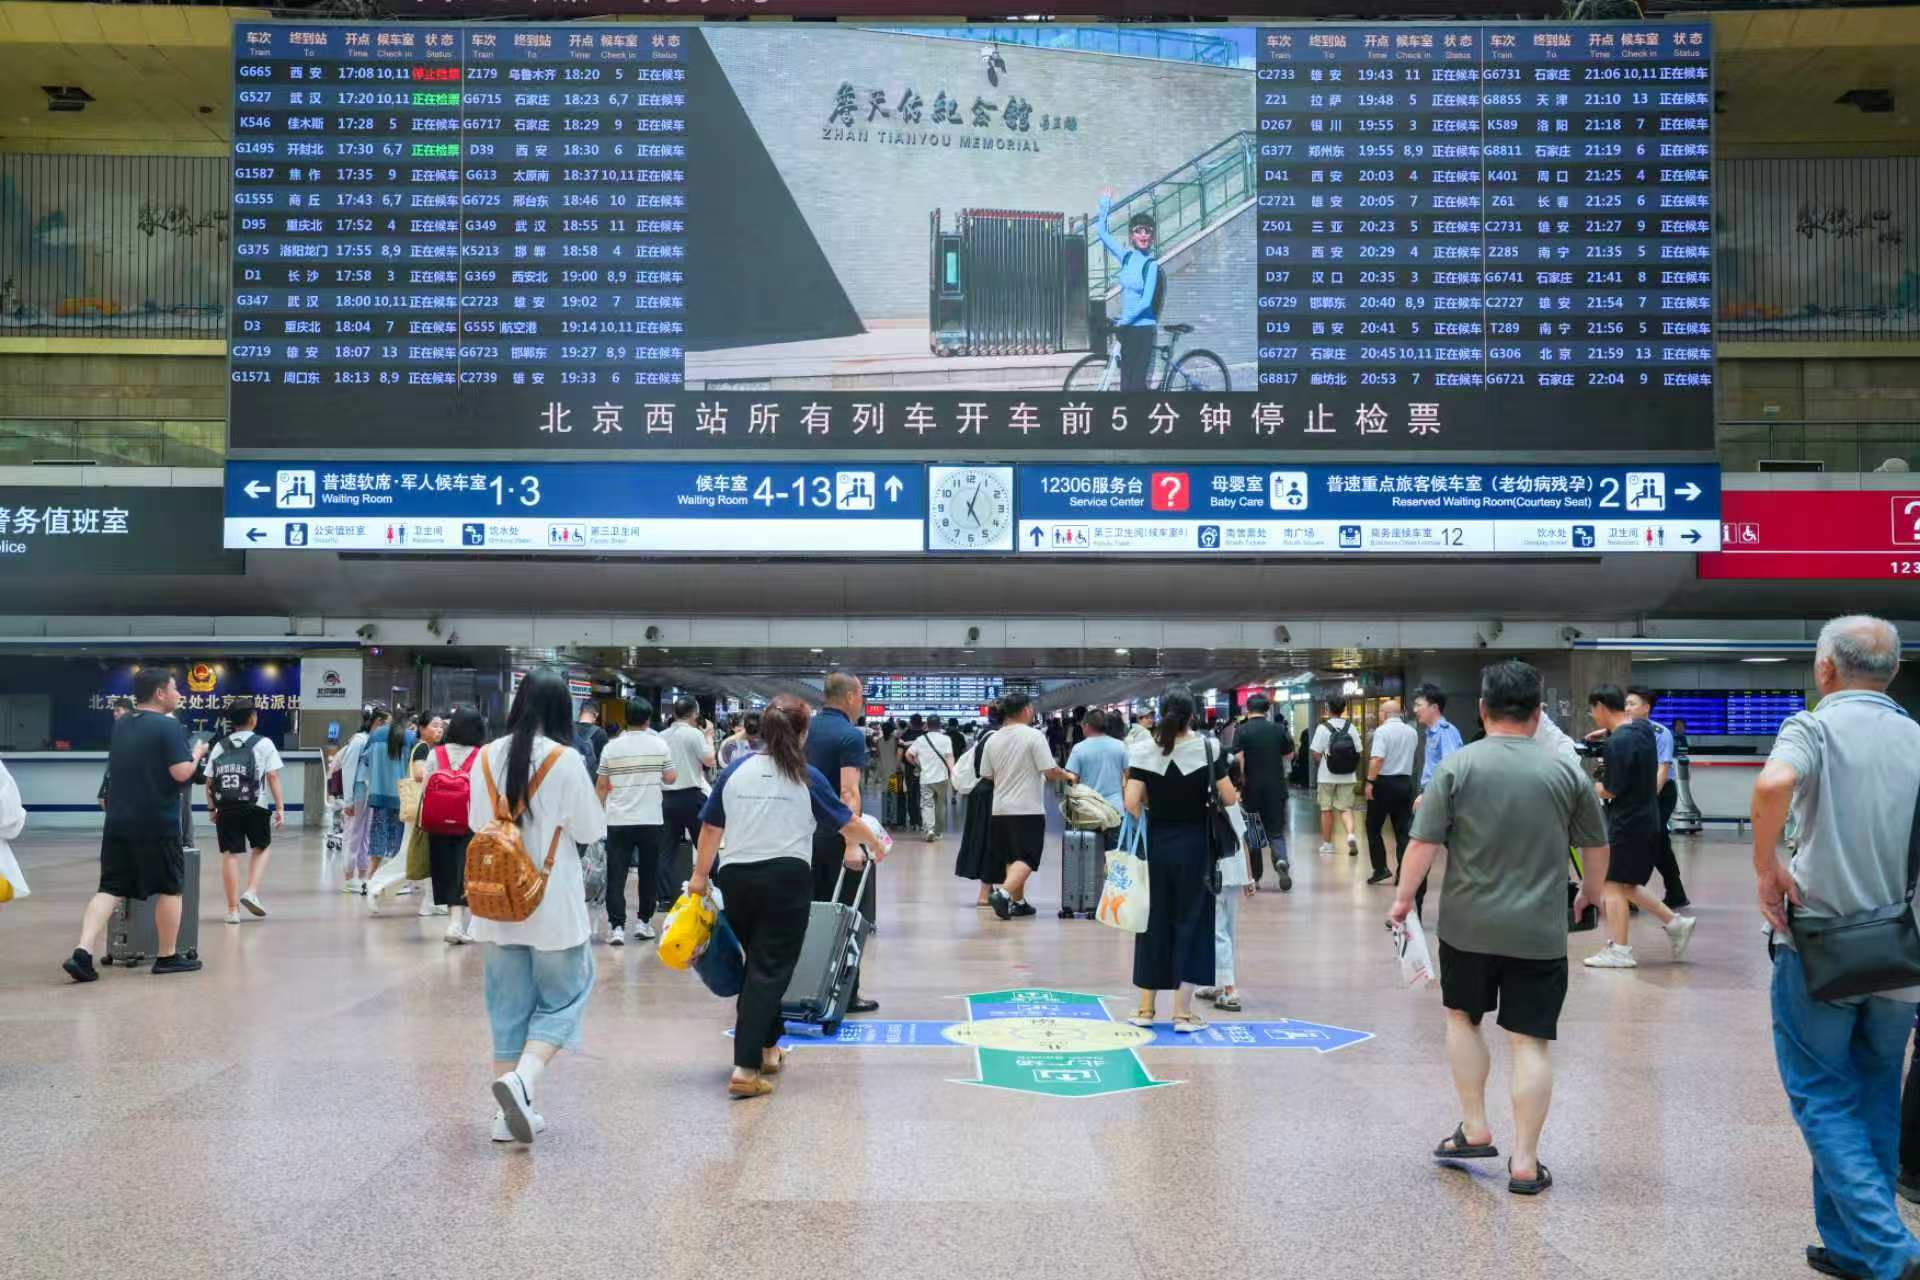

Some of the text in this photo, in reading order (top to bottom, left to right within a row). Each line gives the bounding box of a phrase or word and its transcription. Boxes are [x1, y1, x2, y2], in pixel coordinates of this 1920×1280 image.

[247, 31, 415, 46] 车次 终到站 开点 候车室
[471, 33, 638, 48] 车次 终到站 开点 候车室
[1266, 34, 1433, 48] 车次 终到站 开点 候车室
[1489, 32, 1659, 47] 车次 终到站 开点 候车室
[239, 65, 272, 78] G665
[338, 67, 375, 79] 17:08
[467, 67, 498, 79] Z179
[1257, 68, 1295, 80] C2733
[1484, 67, 1621, 81] G6731 石家庄 21:06
[239, 91, 272, 103] G527
[464, 93, 600, 106] G6715 石家庄 18:23
[1264, 93, 1288, 105] Z21
[1484, 94, 1522, 105] G8855
[240, 116, 324, 130] K546 佳木斯
[463, 118, 502, 130] G6717
[1261, 119, 1394, 131] D267 19:55
[1487, 119, 1518, 130] K589
[822, 128, 1040, 152] ZHAN TIANYOU MEMORIAL
[235, 142, 374, 155] G1495 17:30
[469, 143, 494, 156] D39
[1260, 144, 1345, 158] G377 郑州东
[1484, 144, 1622, 156] G8811 21:19
[234, 167, 275, 179] G1587
[465, 169, 600, 183] G613 太原南 18:37
[1264, 170, 1289, 182] D41
[1487, 170, 1518, 182] K401
[234, 193, 274, 205] G1555
[462, 194, 501, 206] G6725
[1258, 194, 1395, 207] C2721 20:05
[1491, 195, 1515, 207] Z61
[241, 218, 373, 232] D95 重庆北 17:52
[465, 219, 497, 231] G349
[1262, 220, 1292, 232] Z501
[1485, 219, 1622, 233] C2731 21:27
[237, 243, 270, 255] G375
[462, 244, 598, 257] K5213 18:58
[1265, 245, 1290, 257] D43
[1488, 246, 1519, 258] Z285
[244, 268, 262, 281] D1
[464, 270, 497, 282] G369
[1265, 271, 1396, 283] D37 20:35
[1486, 271, 1524, 283] G6741
[236, 295, 372, 307] G347 18:00
[461, 295, 499, 307] C2723
[1258, 296, 1297, 308] G6729
[1486, 296, 1624, 309] C2727 21:54
[243, 319, 261, 332] D3
[463, 320, 598, 333] G555 19:14
[1266, 321, 1291, 333] D19
[1489, 322, 1520, 334] T289
[232, 345, 272, 357] C2719
[461, 346, 499, 358] G6723
[1258, 346, 1396, 361] G6727 石家庄 20:45
[1489, 347, 1522, 359] G306
[231, 370, 370, 384] G1571 18:13
[460, 371, 498, 384] C2739
[1258, 372, 1298, 384] G8817
[1487, 372, 1625, 386] G6721 石家庄 22:04
[540, 402, 1440, 435] 北京西站所有列车开车前5分钟停止检票
[322, 472, 487, 492] 普速软席·军人候车室
[1040, 476, 1143, 495] 12306服务台
[1211, 474, 1264, 493] 母婴室
[695, 474, 832, 508] 候车室 4-13
[1599, 477, 1620, 508] 2
[321, 493, 393, 506] Waiting Room
[677, 494, 749, 508] Waiting Room
[1069, 496, 1145, 507] Service Center
[1210, 496, 1265, 509] Baby Care
[1392, 496, 1592, 509] Reserved Waiting Room(Courtesy Seat)
[1440, 528, 1464, 546] 12
[0, 541, 26, 553] lice
[222, 774, 240, 788] 23
